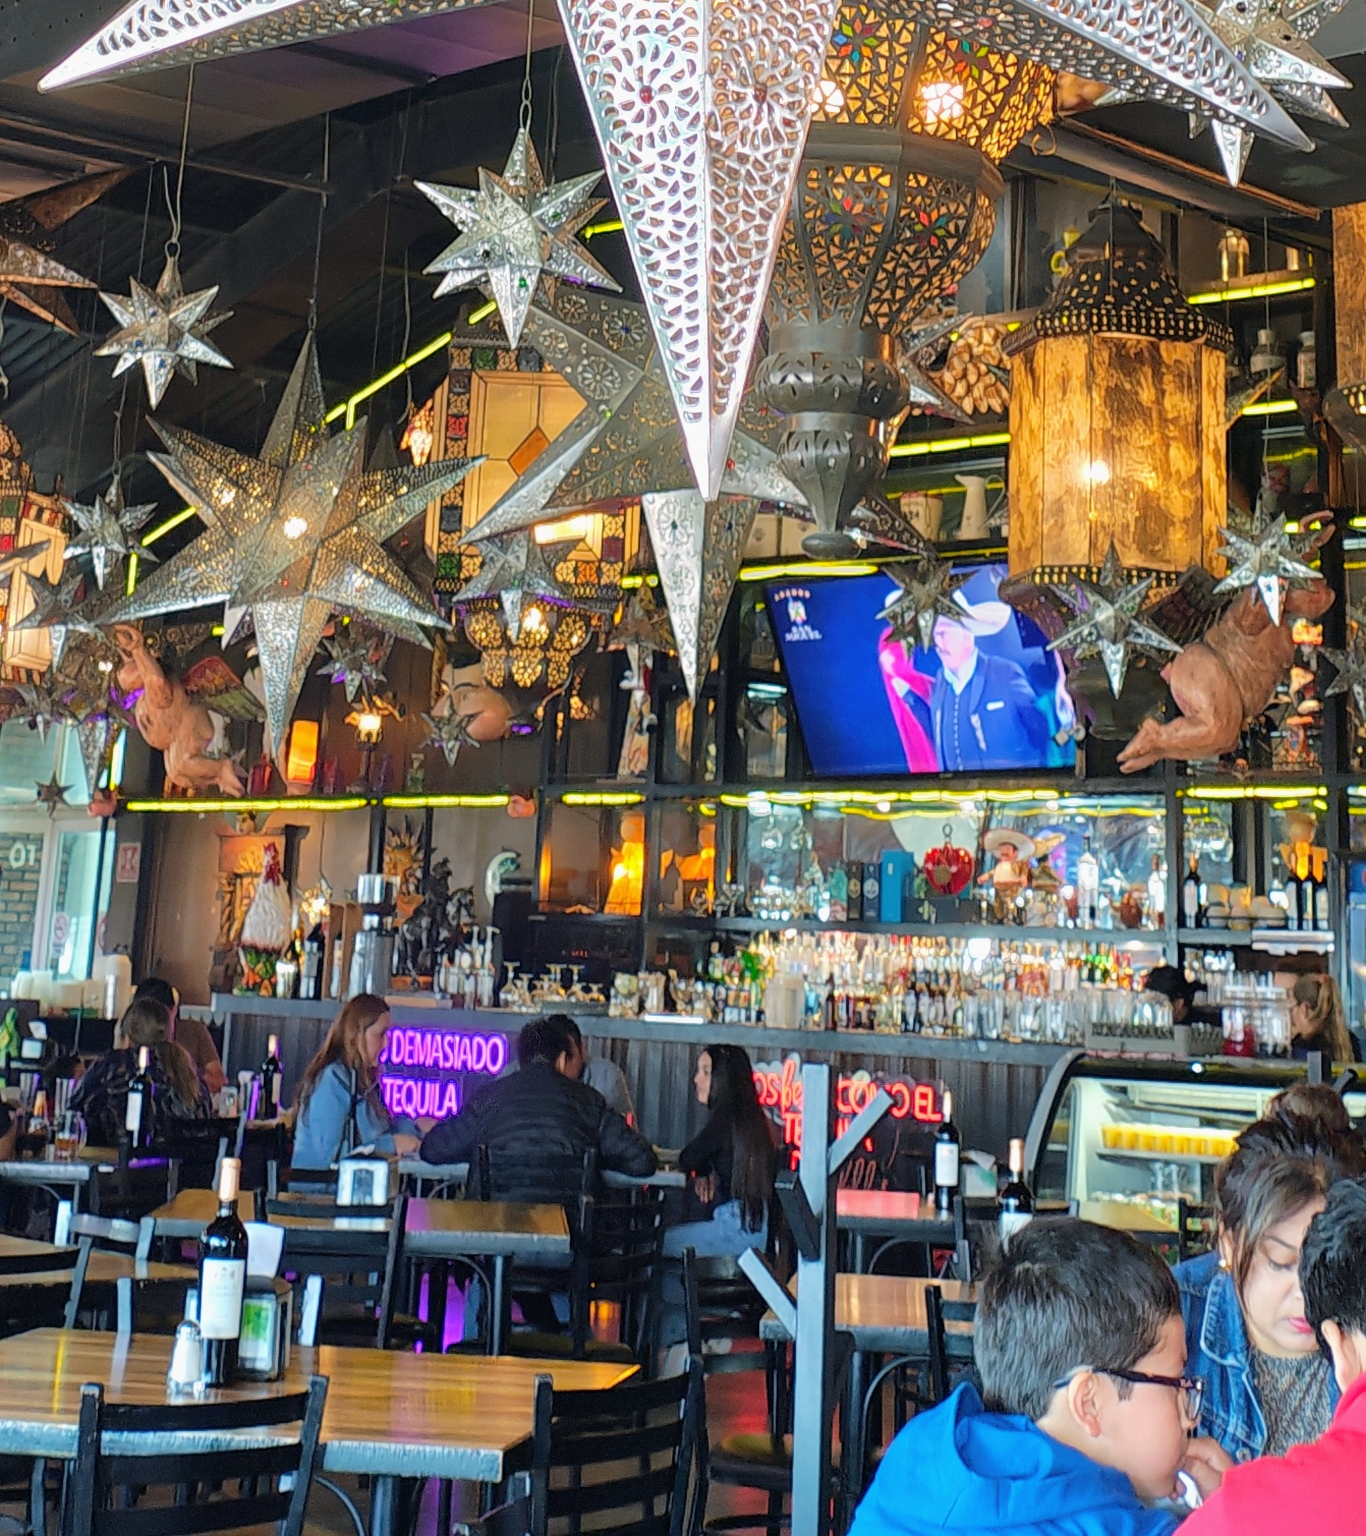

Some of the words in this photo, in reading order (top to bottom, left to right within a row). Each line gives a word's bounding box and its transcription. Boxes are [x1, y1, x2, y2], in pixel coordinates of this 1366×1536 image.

[390, 1028, 506, 1073] DEMASIADO
[381, 1077, 459, 1120] TEQUILA
[913, 1083, 944, 1123] EL
